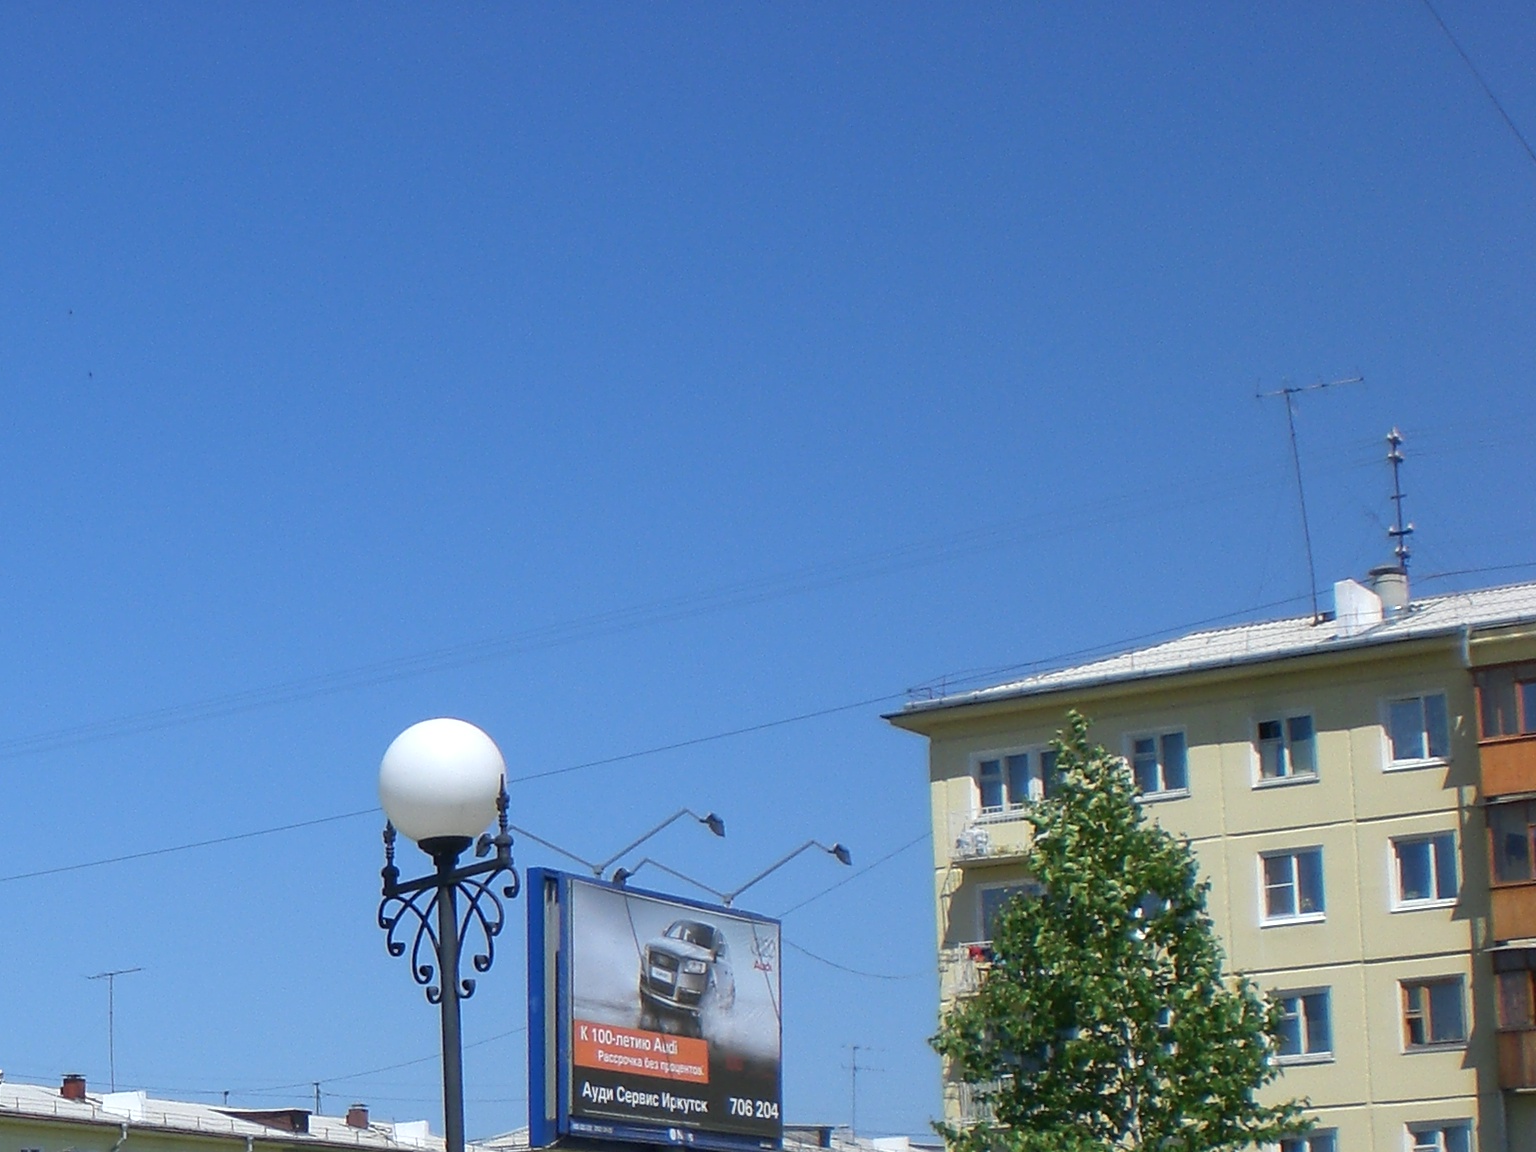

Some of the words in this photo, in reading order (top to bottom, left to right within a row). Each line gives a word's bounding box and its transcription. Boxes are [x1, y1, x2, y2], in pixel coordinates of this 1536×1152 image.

[580, 1025, 588, 1041] К
[591, 1028, 651, 1051] 100-летию
[654, 1037, 678, 1055] Audi
[597, 1050, 643, 1067] Рассрочка
[644, 1056, 659, 1070] без
[582, 1081, 614, 1104] Ауди
[616, 1085, 660, 1109] Сервис
[661, 1091, 709, 1115] Иркутск
[729, 1097, 753, 1117] 706
[755, 1100, 779, 1120] 204
